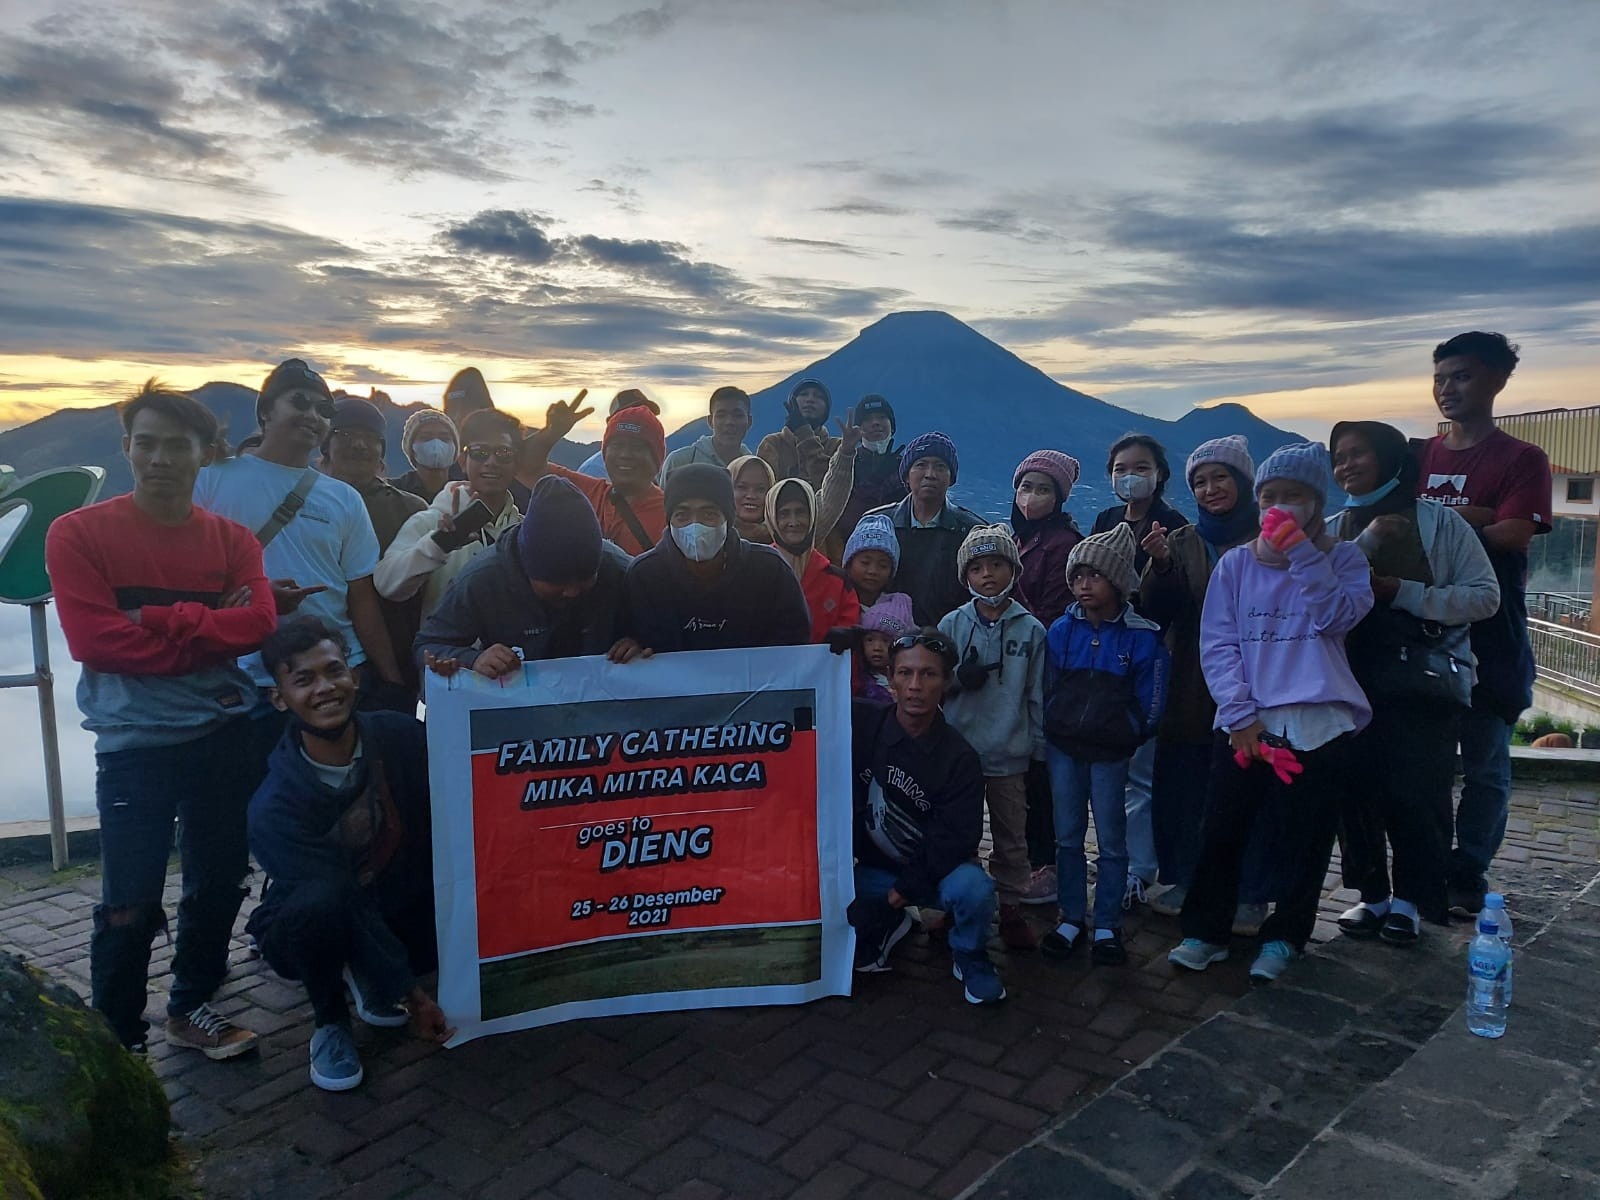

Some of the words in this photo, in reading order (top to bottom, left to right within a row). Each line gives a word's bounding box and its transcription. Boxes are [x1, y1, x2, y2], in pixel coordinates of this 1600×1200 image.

[498, 733, 613, 768] FAMILY
[621, 720, 788, 756] GATHERING
[523, 775, 595, 803] MIKA
[602, 766, 685, 795] MITRA
[692, 761, 763, 786] KACA
[578, 820, 626, 845] goes
[631, 816, 651, 832] to
[601, 826, 712, 869] DIENG
[571, 899, 593, 918] 25
[608, 895, 630, 912] 26
[632, 886, 723, 909] Desember
[627, 907, 669, 927] 2021
